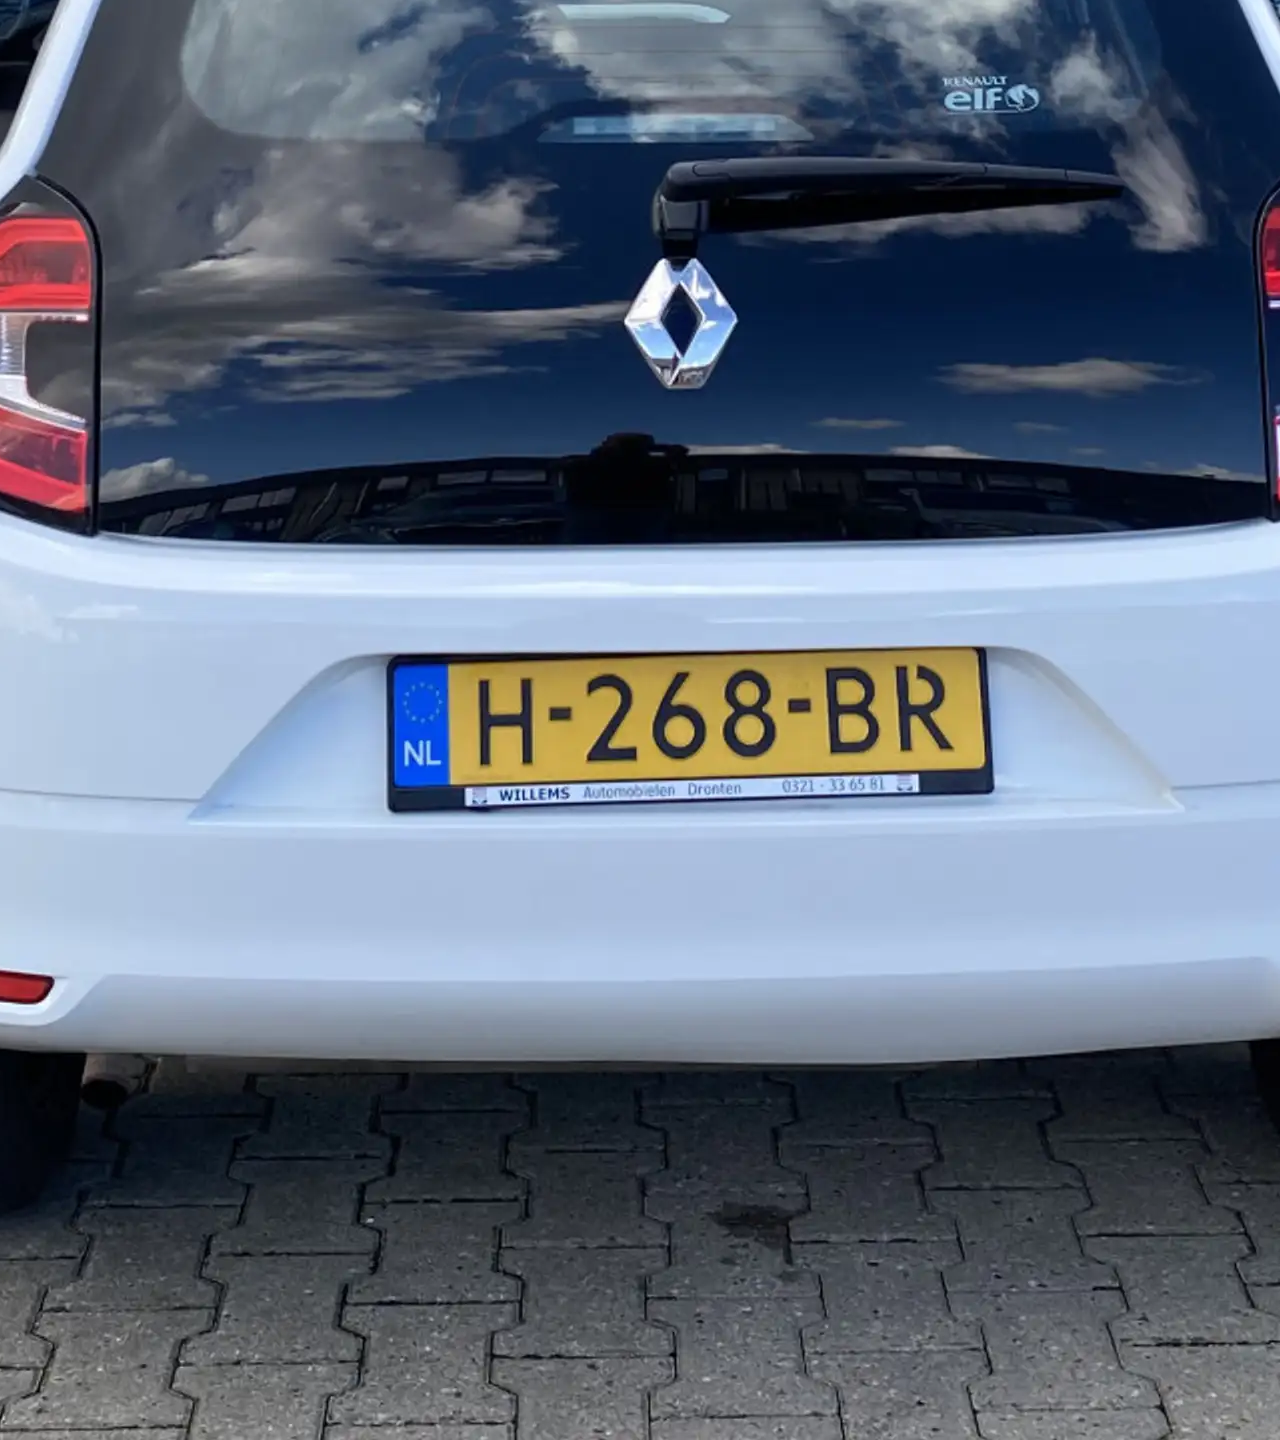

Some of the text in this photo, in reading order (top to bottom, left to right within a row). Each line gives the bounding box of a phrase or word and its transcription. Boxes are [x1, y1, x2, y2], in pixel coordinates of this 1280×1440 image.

[942, 75, 1008, 87] RENAULT
[403, 665, 954, 767] NL H-268-BR
[498, 786, 571, 802] WILLEMS
[583, 781, 676, 800] Automobielen
[686, 780, 743, 797] Dronten
[781, 778, 815, 793] 0321
[828, 777, 846, 791] 33
[849, 776, 865, 791] 65
[869, 775, 885, 791] 81
